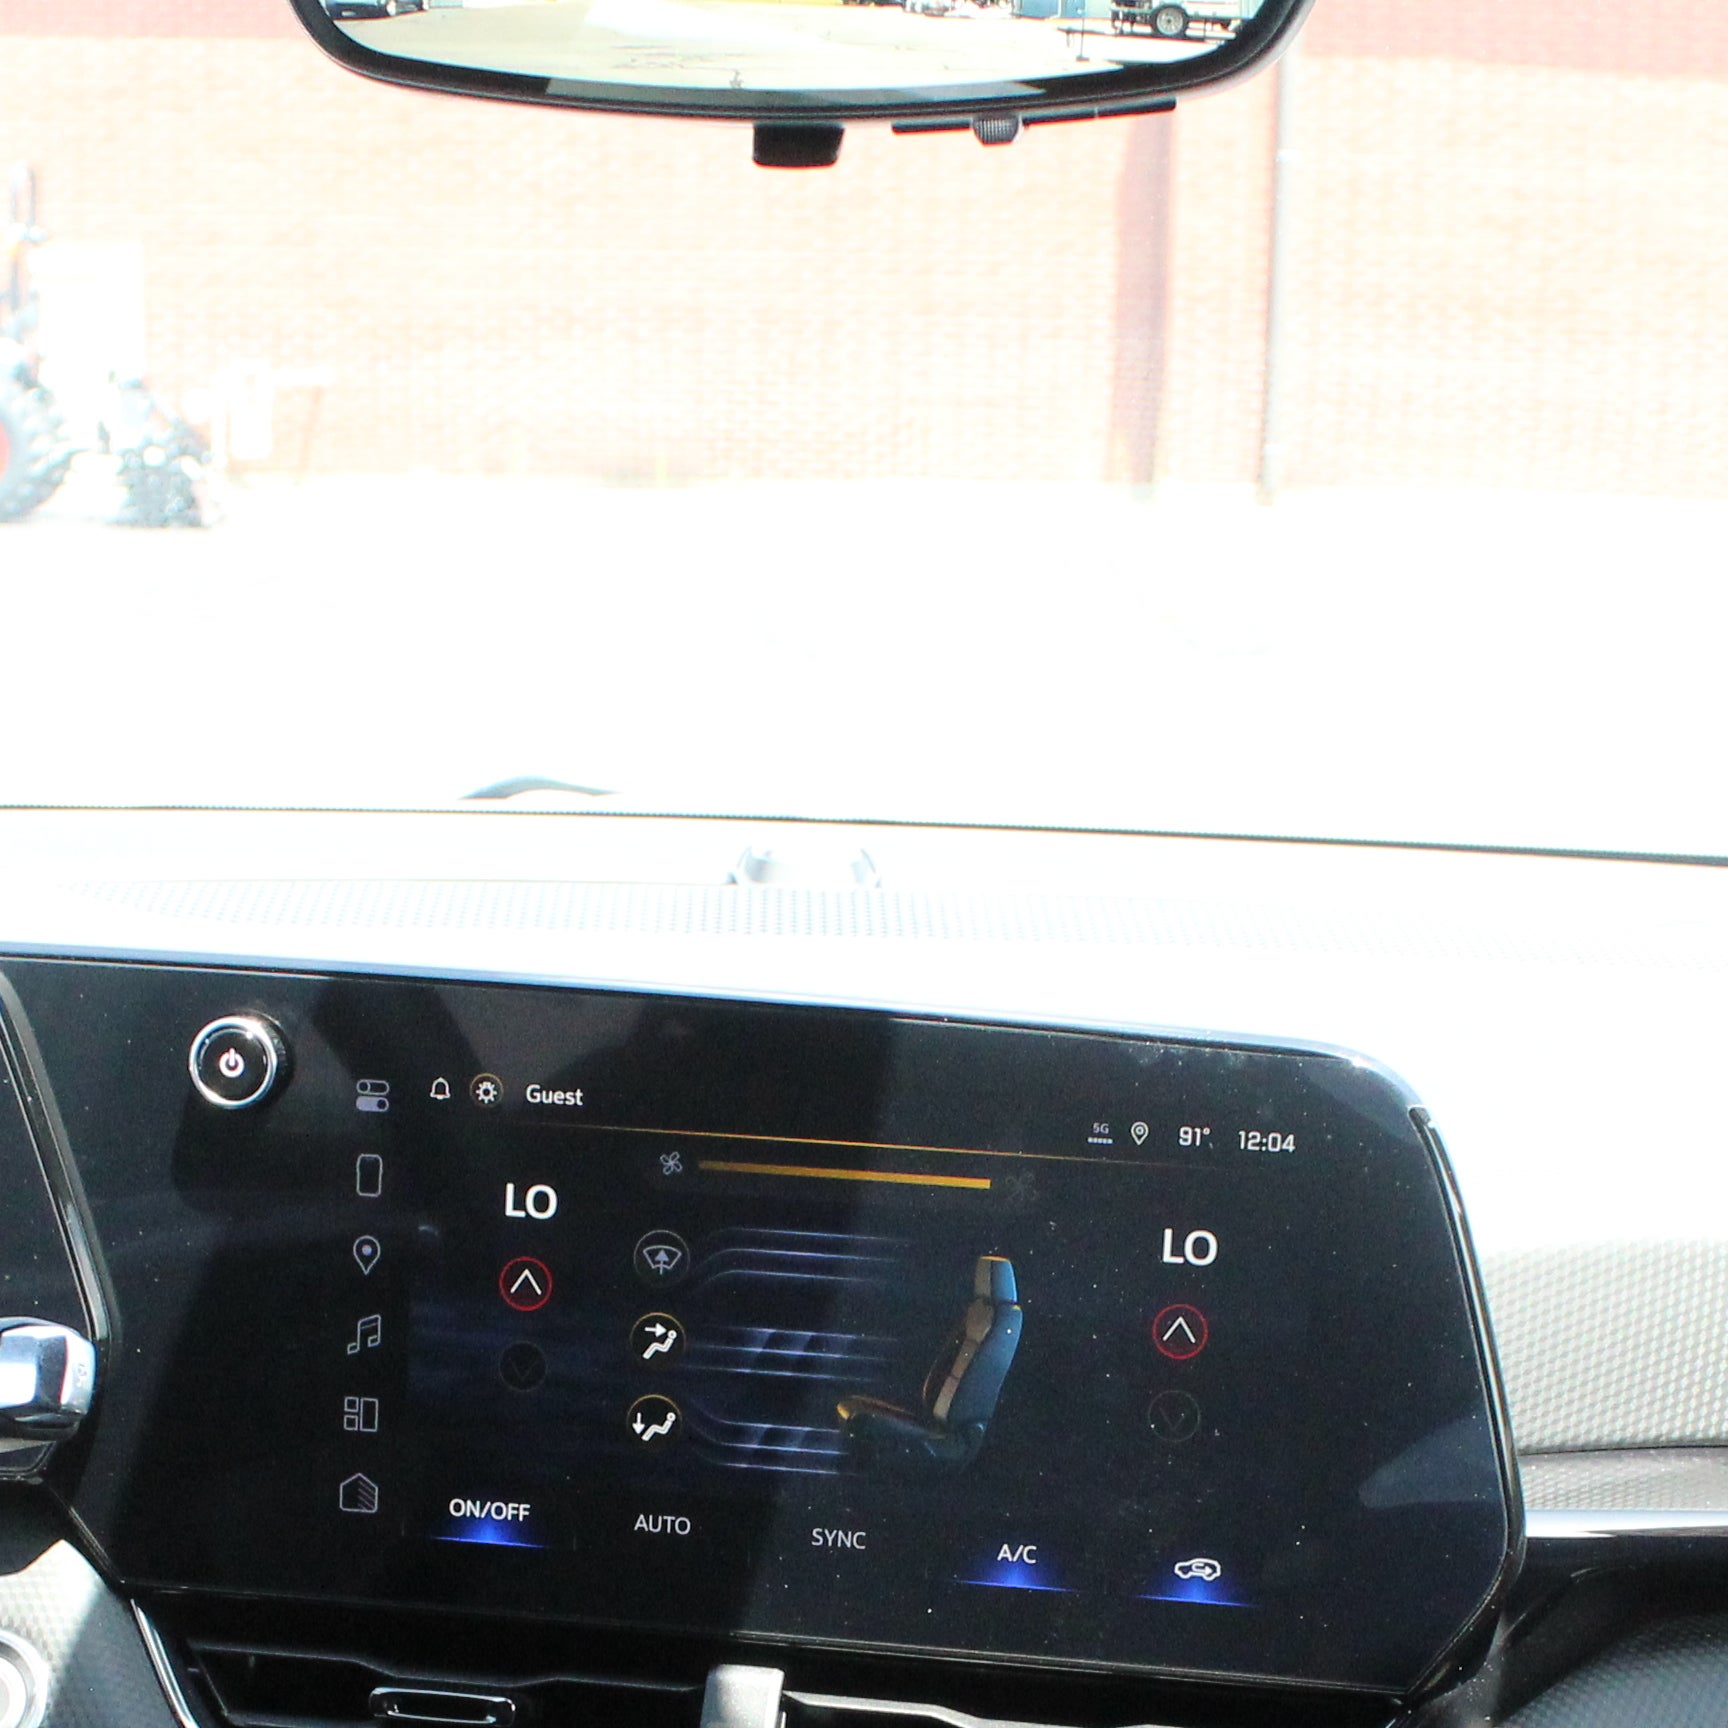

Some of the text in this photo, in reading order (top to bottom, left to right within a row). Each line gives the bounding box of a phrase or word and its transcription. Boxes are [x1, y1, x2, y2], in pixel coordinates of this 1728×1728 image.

[525, 1084, 584, 1106] Guest
[1092, 1122, 1110, 1135] 5G
[1237, 1130, 1296, 1152] 12:04
[504, 1182, 558, 1220] LO
[1161, 1228, 1218, 1266] LO
[448, 1498, 531, 1523] ON/OFF
[633, 1513, 691, 1536] AUTO
[810, 1528, 867, 1551] SYNC
[997, 1543, 1038, 1564] A/C
